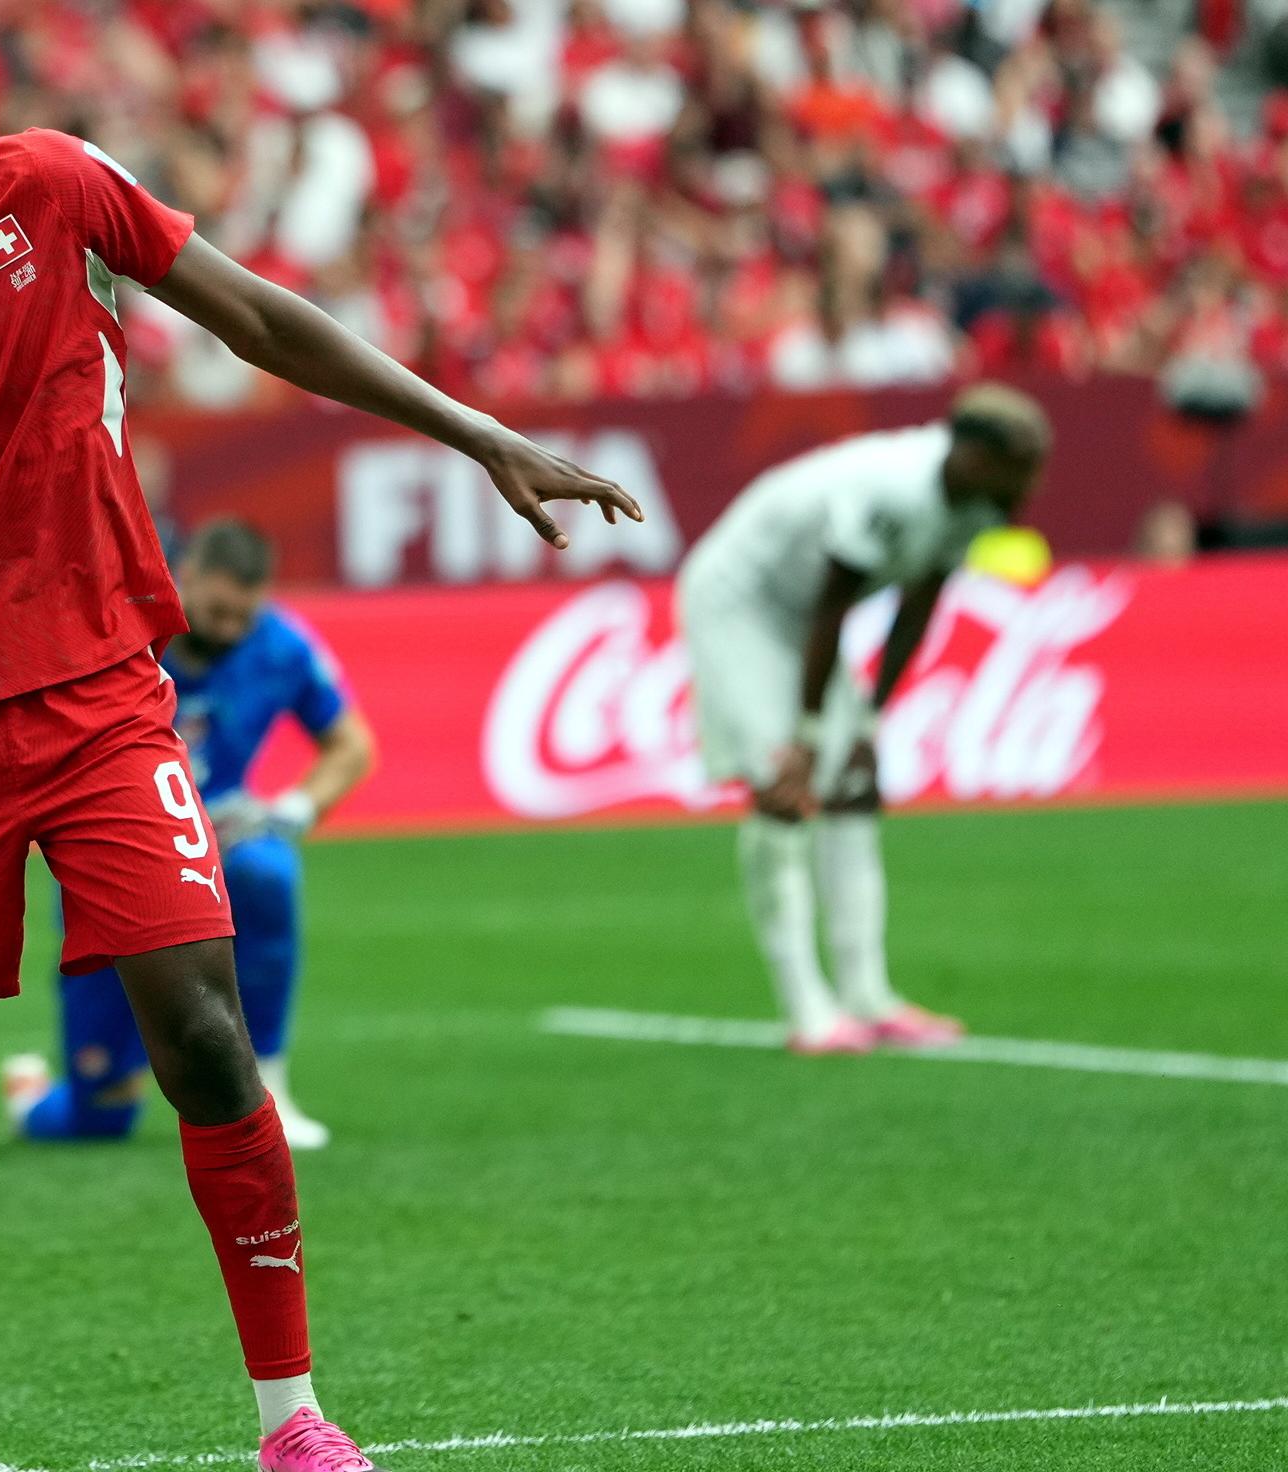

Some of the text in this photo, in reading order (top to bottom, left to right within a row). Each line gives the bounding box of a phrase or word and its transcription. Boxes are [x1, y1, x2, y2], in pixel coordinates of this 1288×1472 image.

[479, 562, 1136, 818] Cocola
[153, 761, 209, 859] 9
[235, 1219, 299, 1245] suisse
